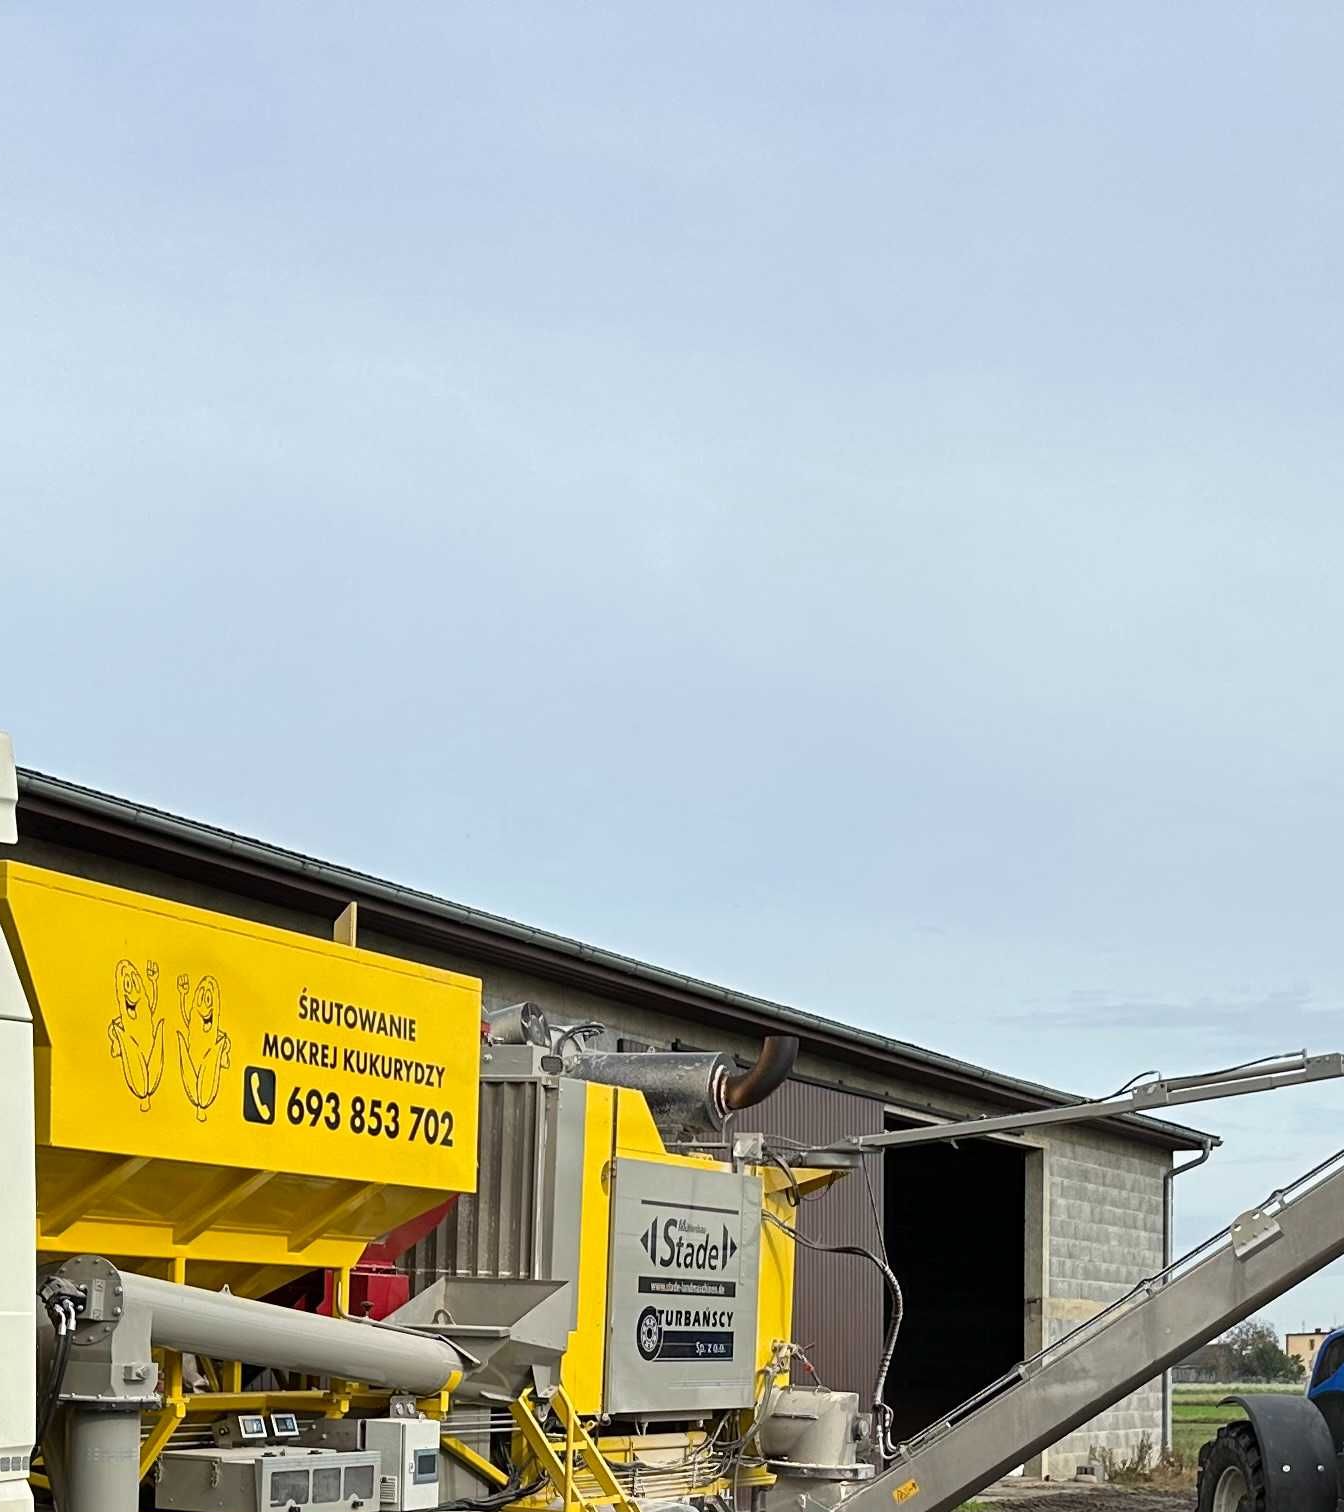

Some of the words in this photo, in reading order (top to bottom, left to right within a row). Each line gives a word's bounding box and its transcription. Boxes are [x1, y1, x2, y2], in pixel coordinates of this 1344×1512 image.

[298, 987, 417, 1043] ŚRUTOWANIE
[262, 1032, 339, 1070] MOKREJ
[343, 1048, 446, 1089] KUKURYDZY
[286, 1087, 342, 1131] 693
[349, 1095, 401, 1140] 853
[408, 1106, 454, 1148] 702
[659, 1217, 720, 1271] Stade
[657, 1306, 734, 1328] TURBAŃSCY
